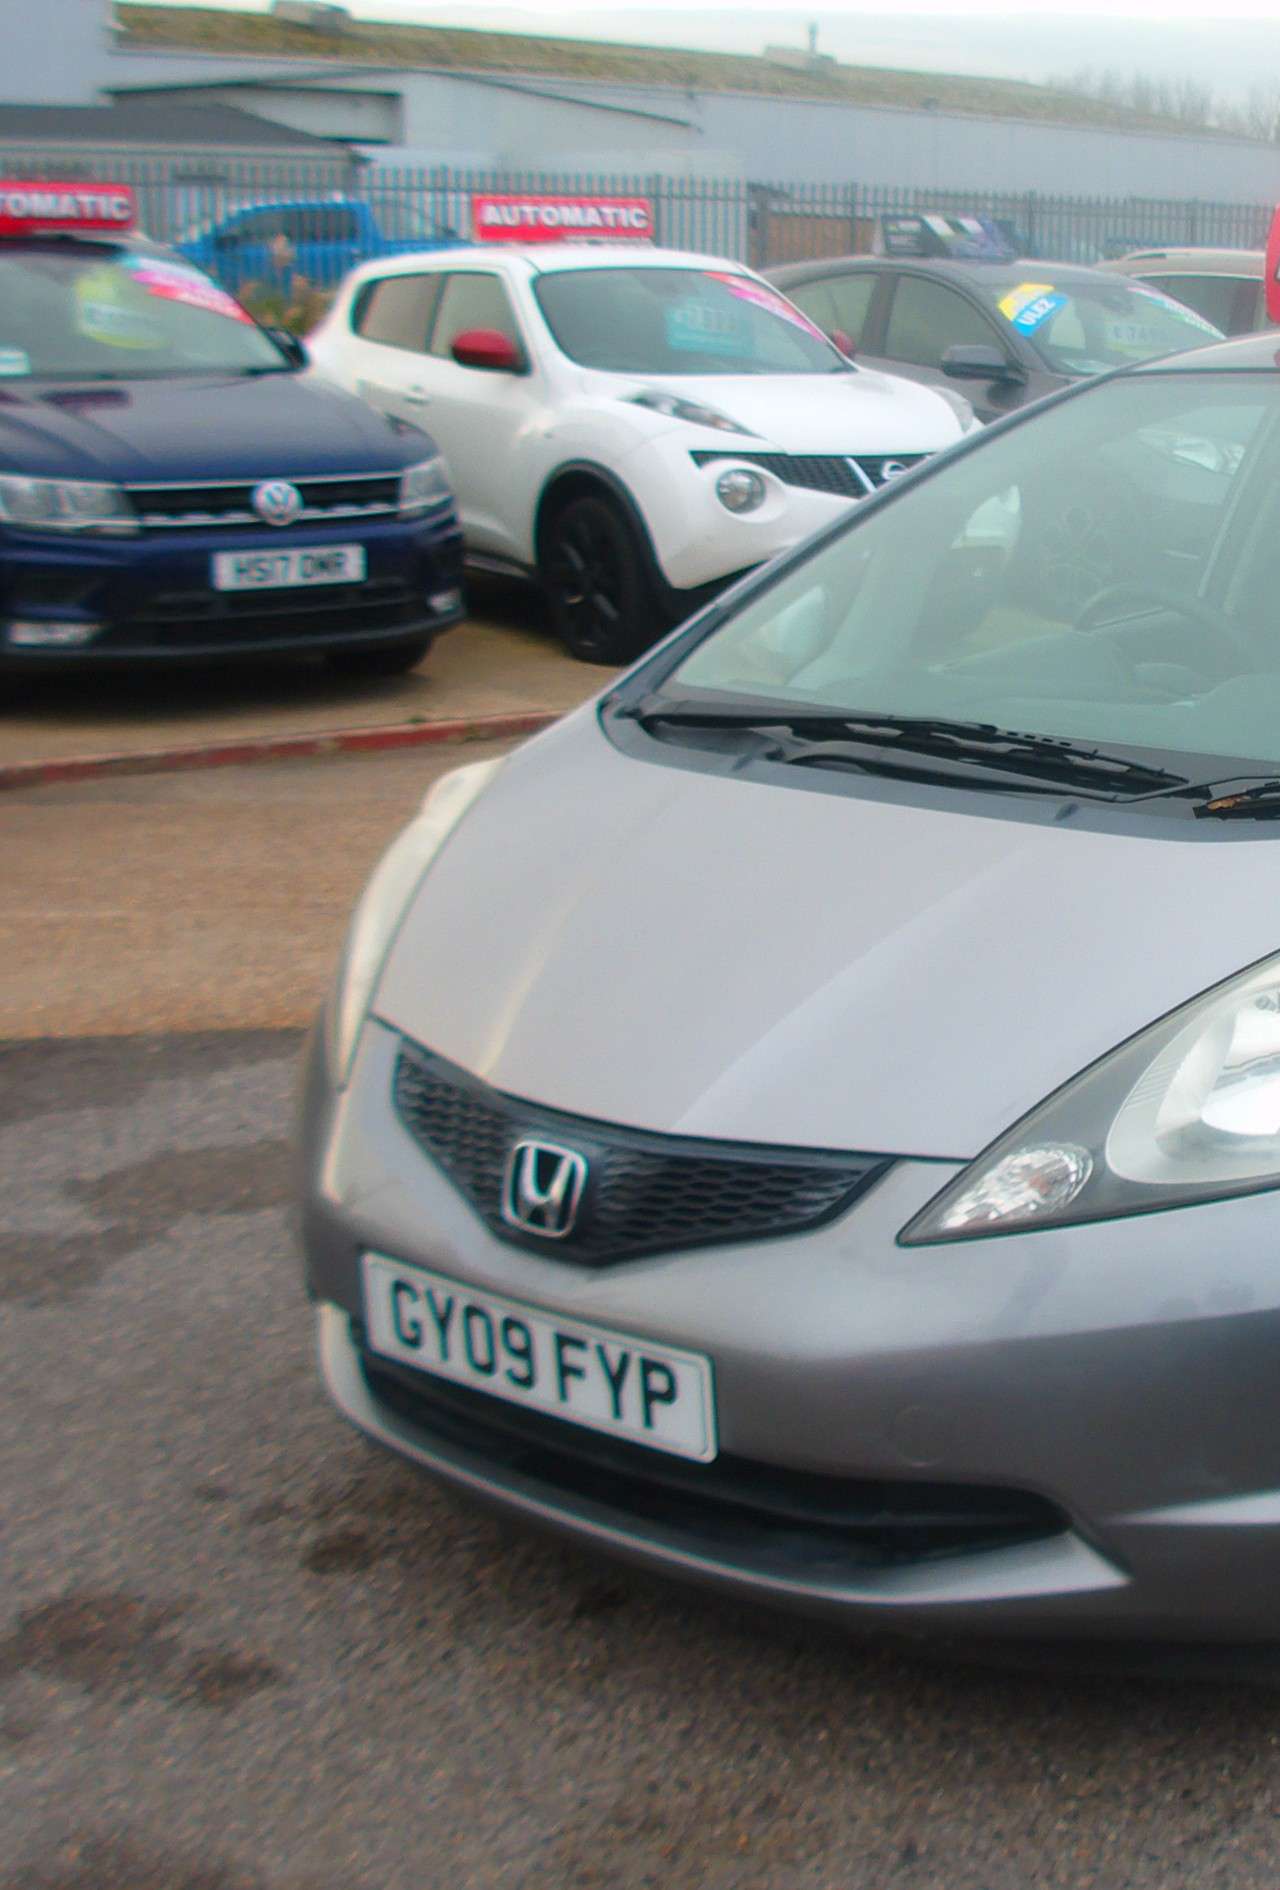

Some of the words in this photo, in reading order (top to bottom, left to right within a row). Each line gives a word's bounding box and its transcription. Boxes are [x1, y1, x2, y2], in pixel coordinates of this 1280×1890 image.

[482, 204, 649, 229] AUTOMATIC
[389, 1278, 537, 1391] GY09
[553, 1331, 679, 1430] FYP
